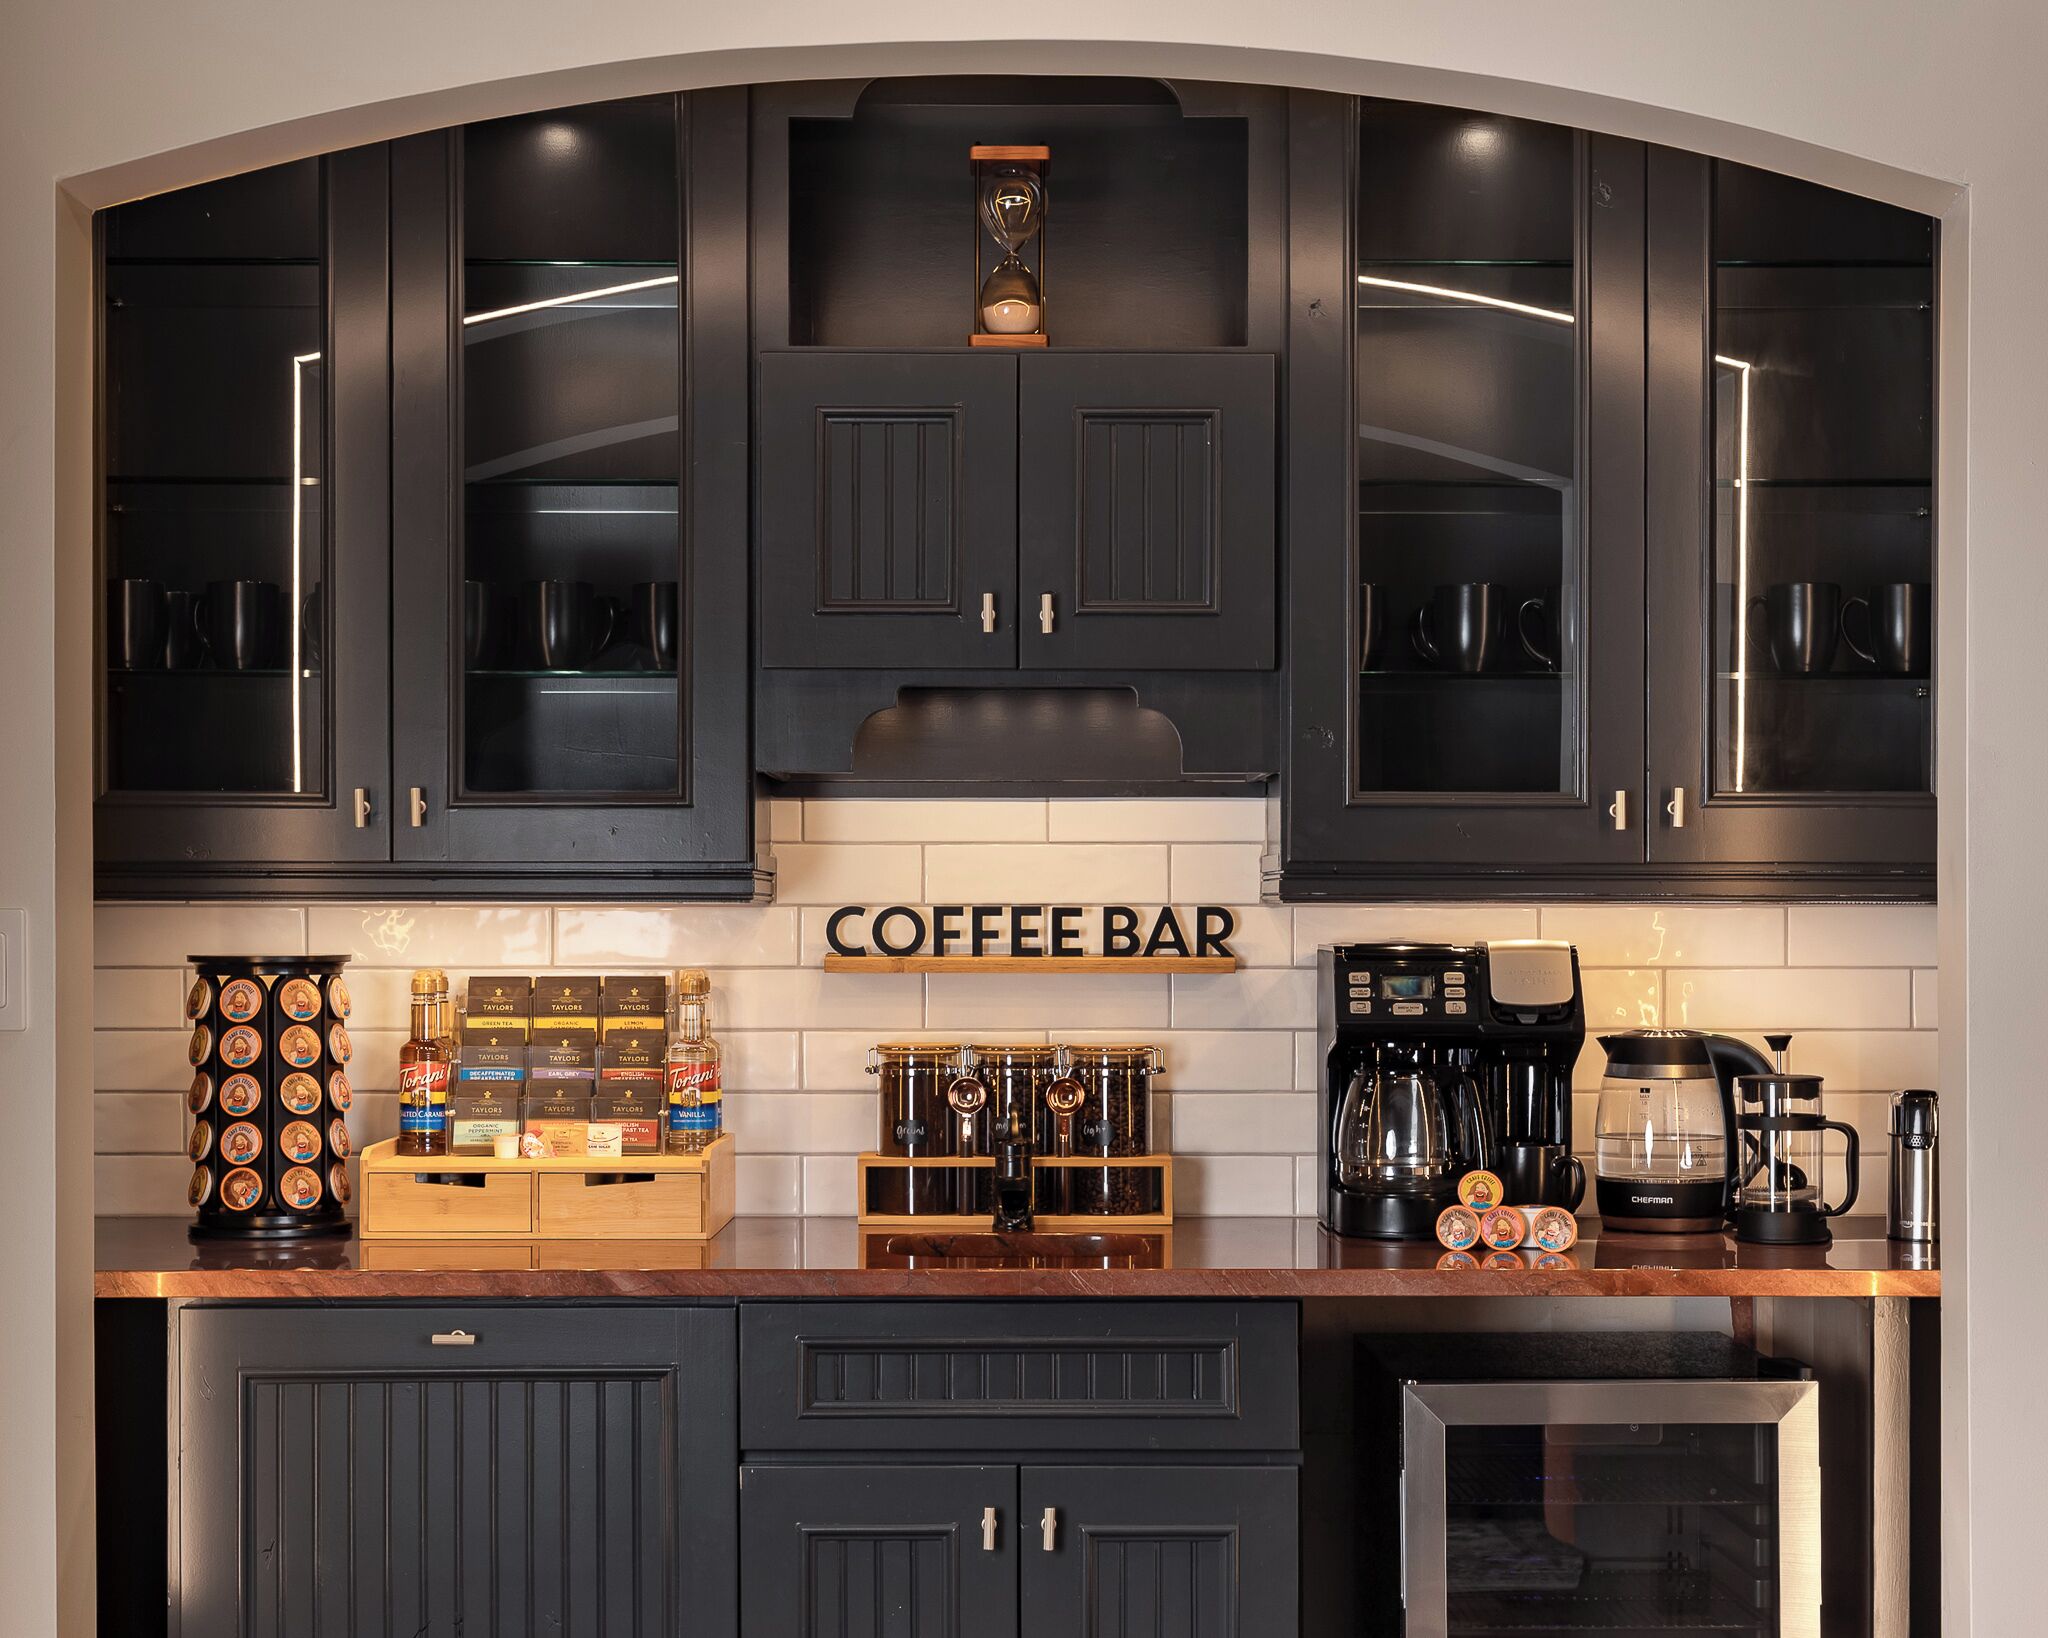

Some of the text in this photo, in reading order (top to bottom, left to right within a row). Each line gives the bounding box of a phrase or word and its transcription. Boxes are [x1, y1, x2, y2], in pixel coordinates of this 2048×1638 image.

[826, 906, 1236, 957] COFFEE BAR
[400, 1064, 445, 1095] Torani
[669, 1064, 715, 1095] Torani
[678, 1110, 706, 1118] VANILLA
[896, 1125, 925, 1139] ground
[1631, 1196, 1674, 1204] CHEFMAN
